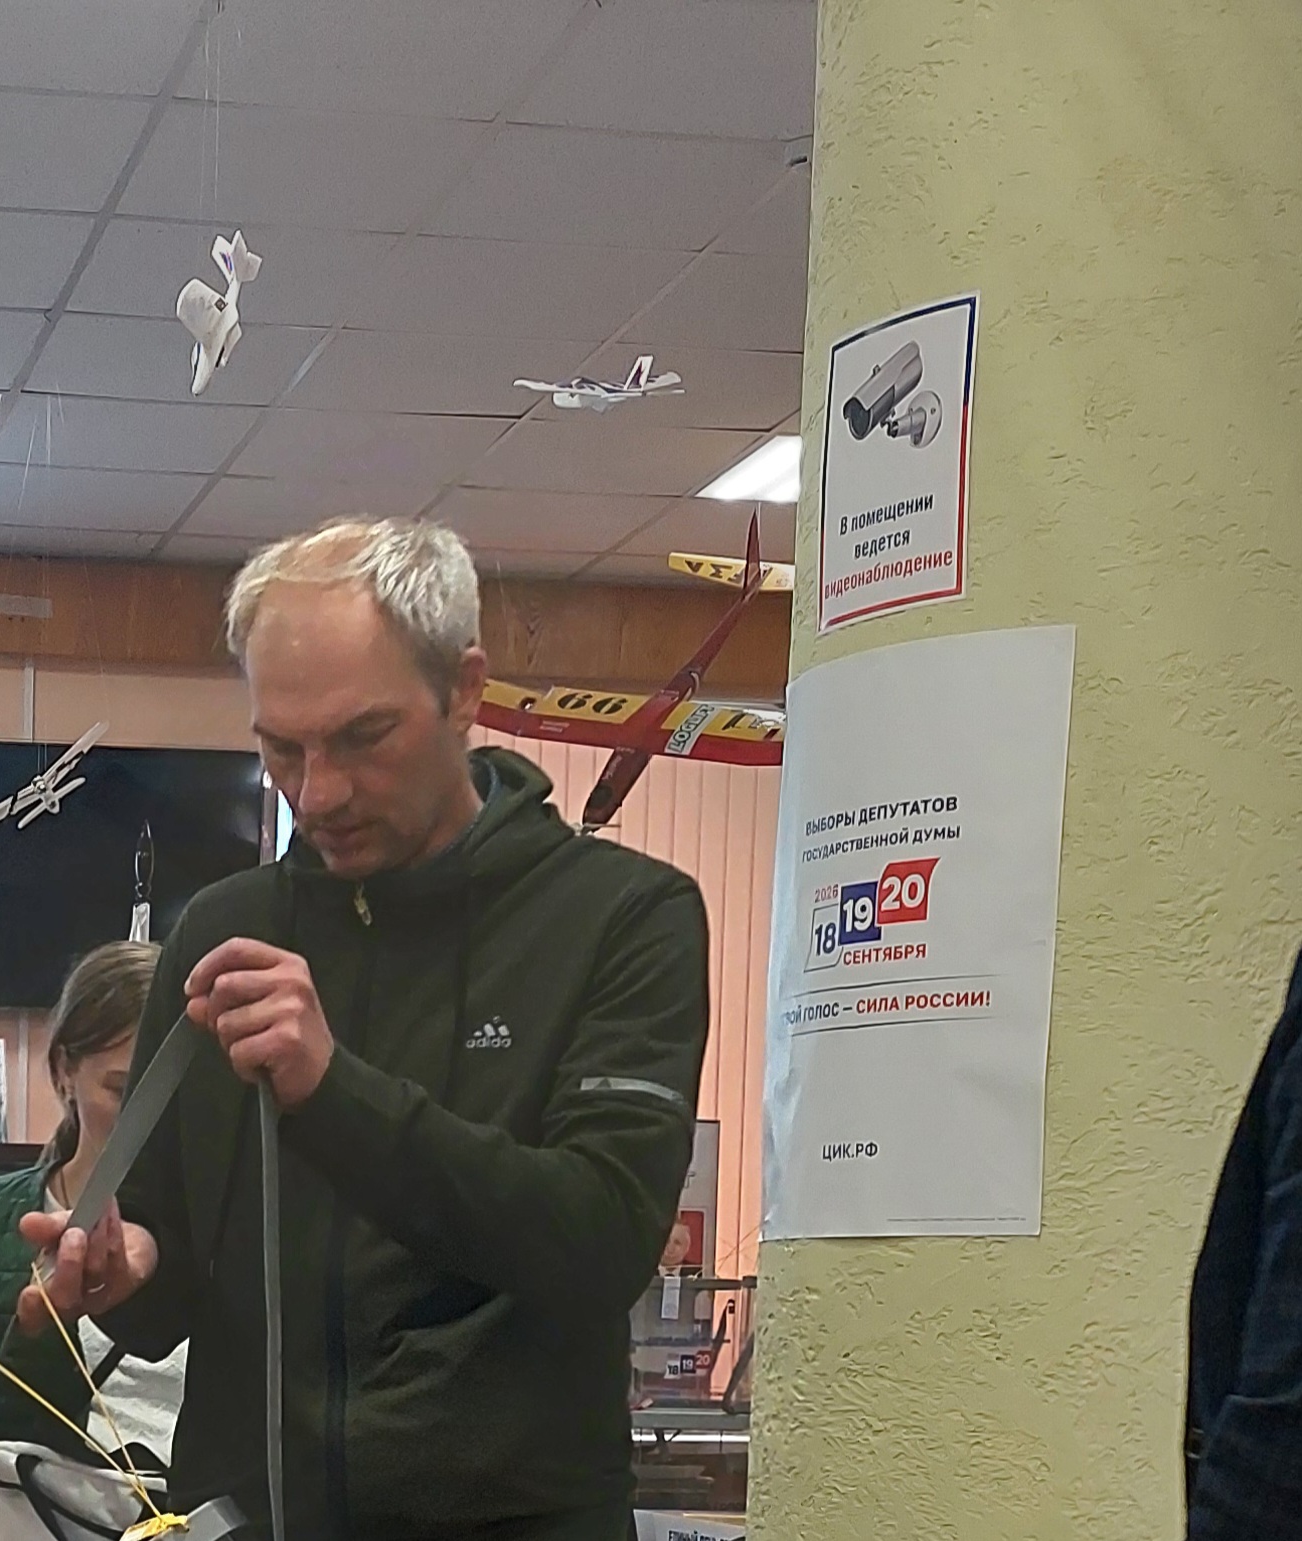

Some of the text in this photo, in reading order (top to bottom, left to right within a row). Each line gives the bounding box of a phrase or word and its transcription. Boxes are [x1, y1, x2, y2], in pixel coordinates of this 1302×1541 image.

[839, 494, 934, 537] В помещении
[854, 528, 911, 560] ведется
[824, 549, 954, 600] видеонаблюдение
[805, 795, 958, 837] ВЫБОРЫ ДЕПУТАТОВ
[802, 825, 961, 864] ГОСУДАРСТВЕННОЙ ДУМЫ
[814, 884, 839, 903] 2026
[814, 873, 927, 957] 18 19 20
[843, 942, 927, 967] СЕНТЯБРЯ
[803, 1002, 840, 1023] ГОЛОС
[856, 995, 900, 1015] СИЛА
[904, 990, 991, 1011] РОССИИ!
[822, 1140, 879, 1162] ЦИК.РФ
